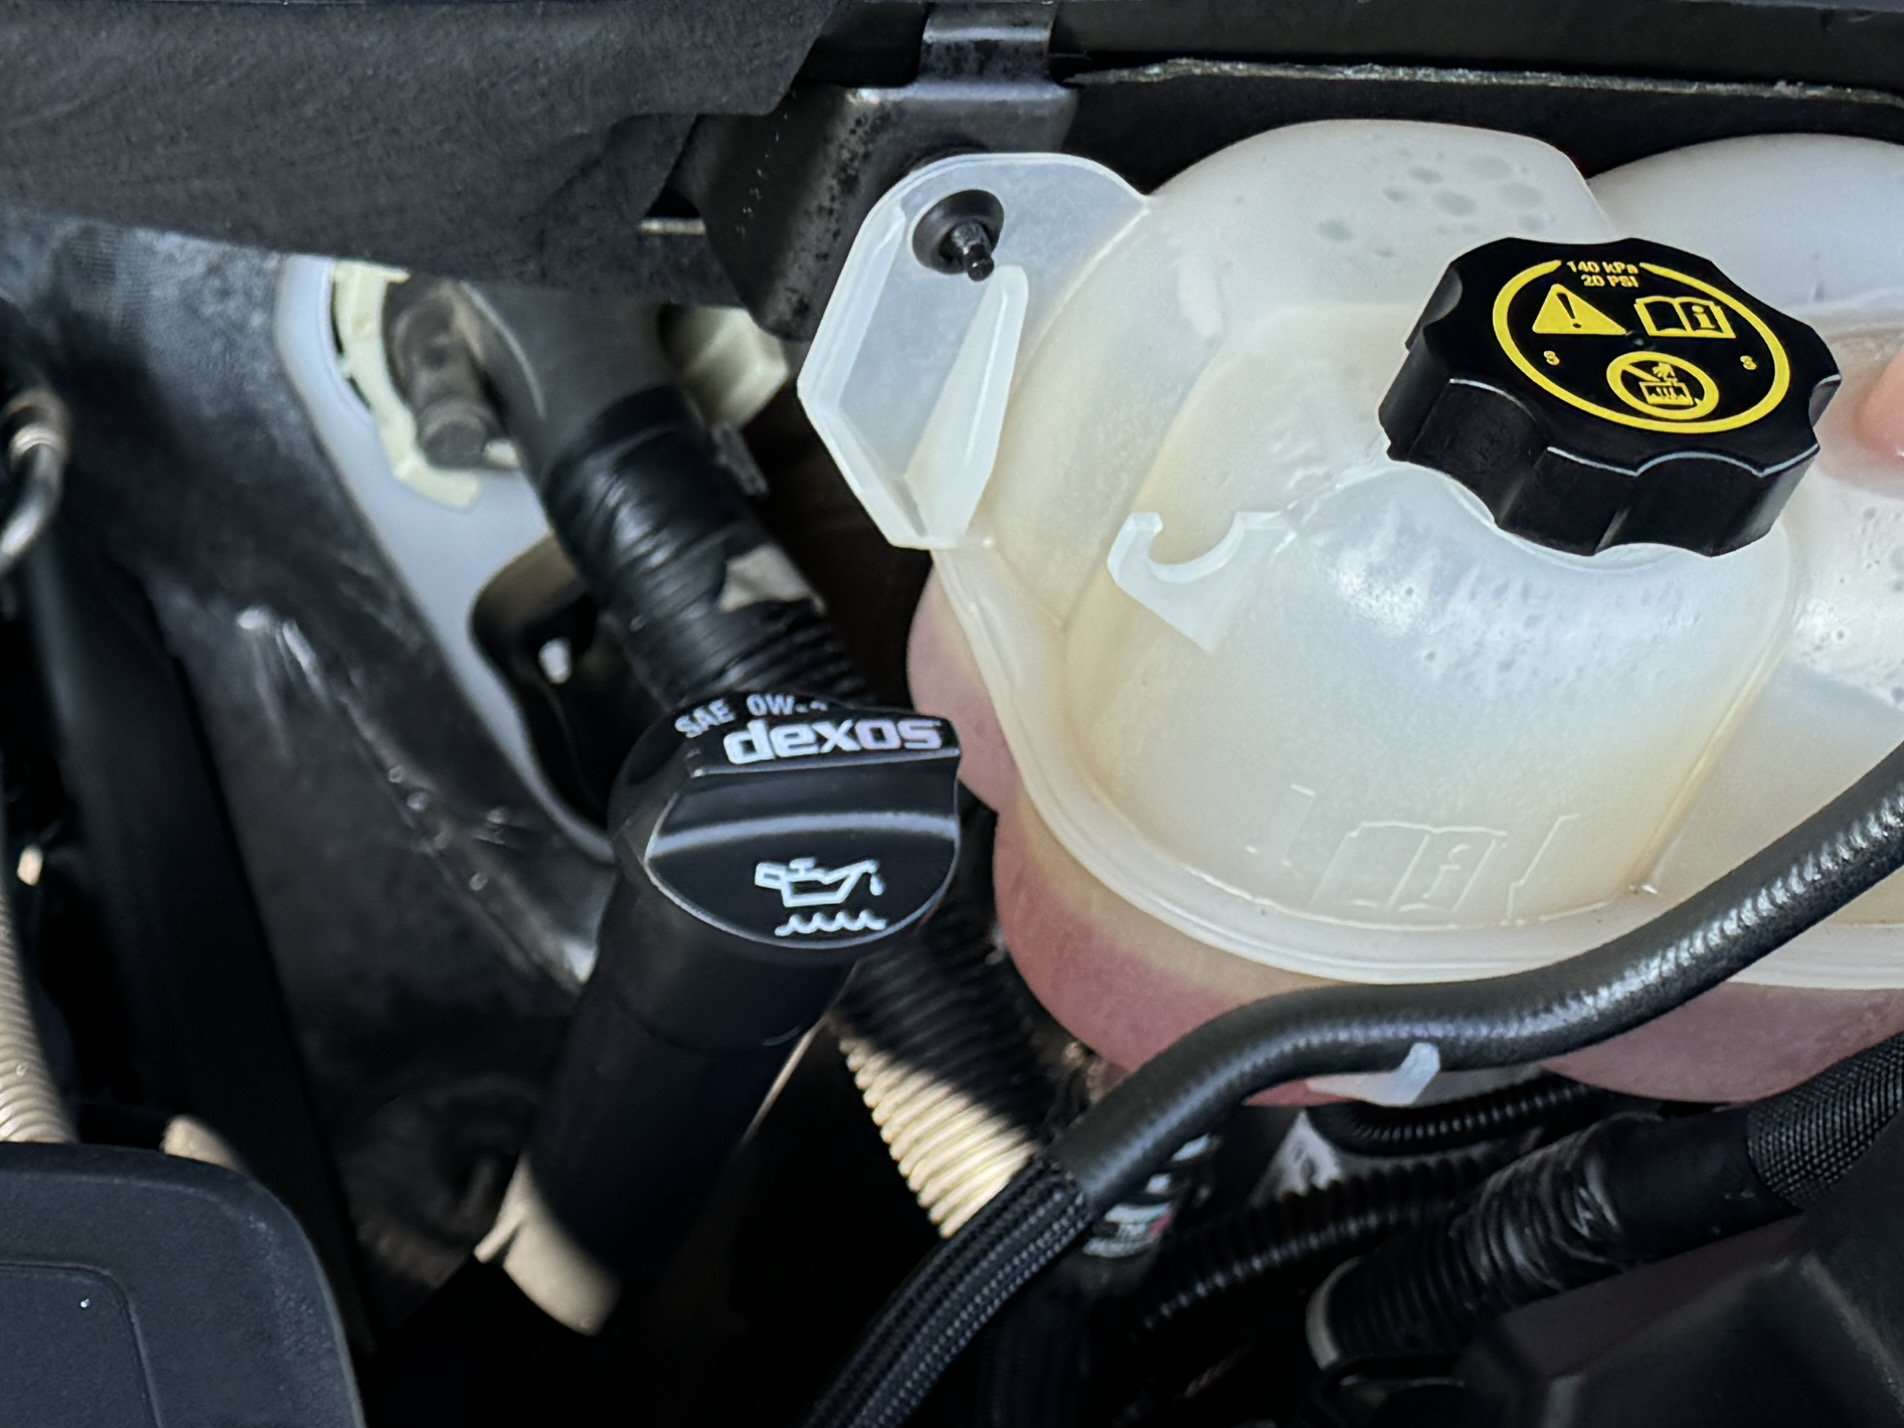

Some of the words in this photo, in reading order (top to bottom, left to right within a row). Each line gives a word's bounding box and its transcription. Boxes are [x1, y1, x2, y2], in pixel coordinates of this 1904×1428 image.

[1566, 260, 1600, 273] 140
[1602, 261, 1639, 274] kPa
[1580, 274, 1605, 287] 20
[1606, 275, 1639, 288] PSI
[674, 698, 736, 738] SAE
[723, 716, 943, 766] dexos
